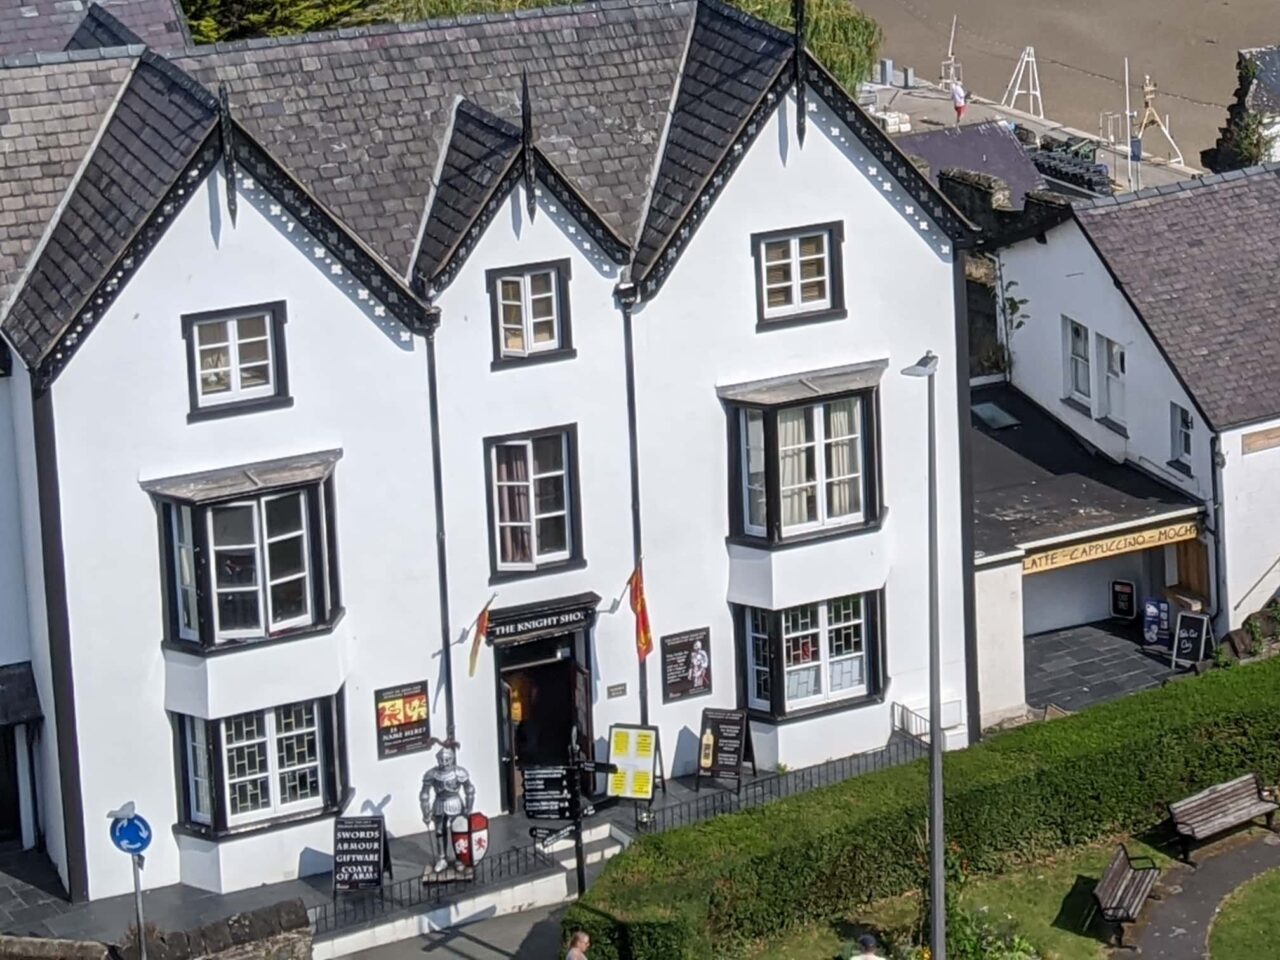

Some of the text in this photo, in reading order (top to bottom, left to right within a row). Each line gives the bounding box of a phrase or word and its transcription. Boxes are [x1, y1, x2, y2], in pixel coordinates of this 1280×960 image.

[1023, 552, 1058, 571] LATTE
[1070, 535, 1146, 561] CAPPUCCINO
[495, 626, 516, 636] THE
[517, 617, 559, 632] KNIGHT
[336, 831, 380, 839] SWORDS
[336, 842, 380, 851] ARMOUR
[336, 854, 379, 862] GIFTWARE
[341, 865, 374, 874] COATS
